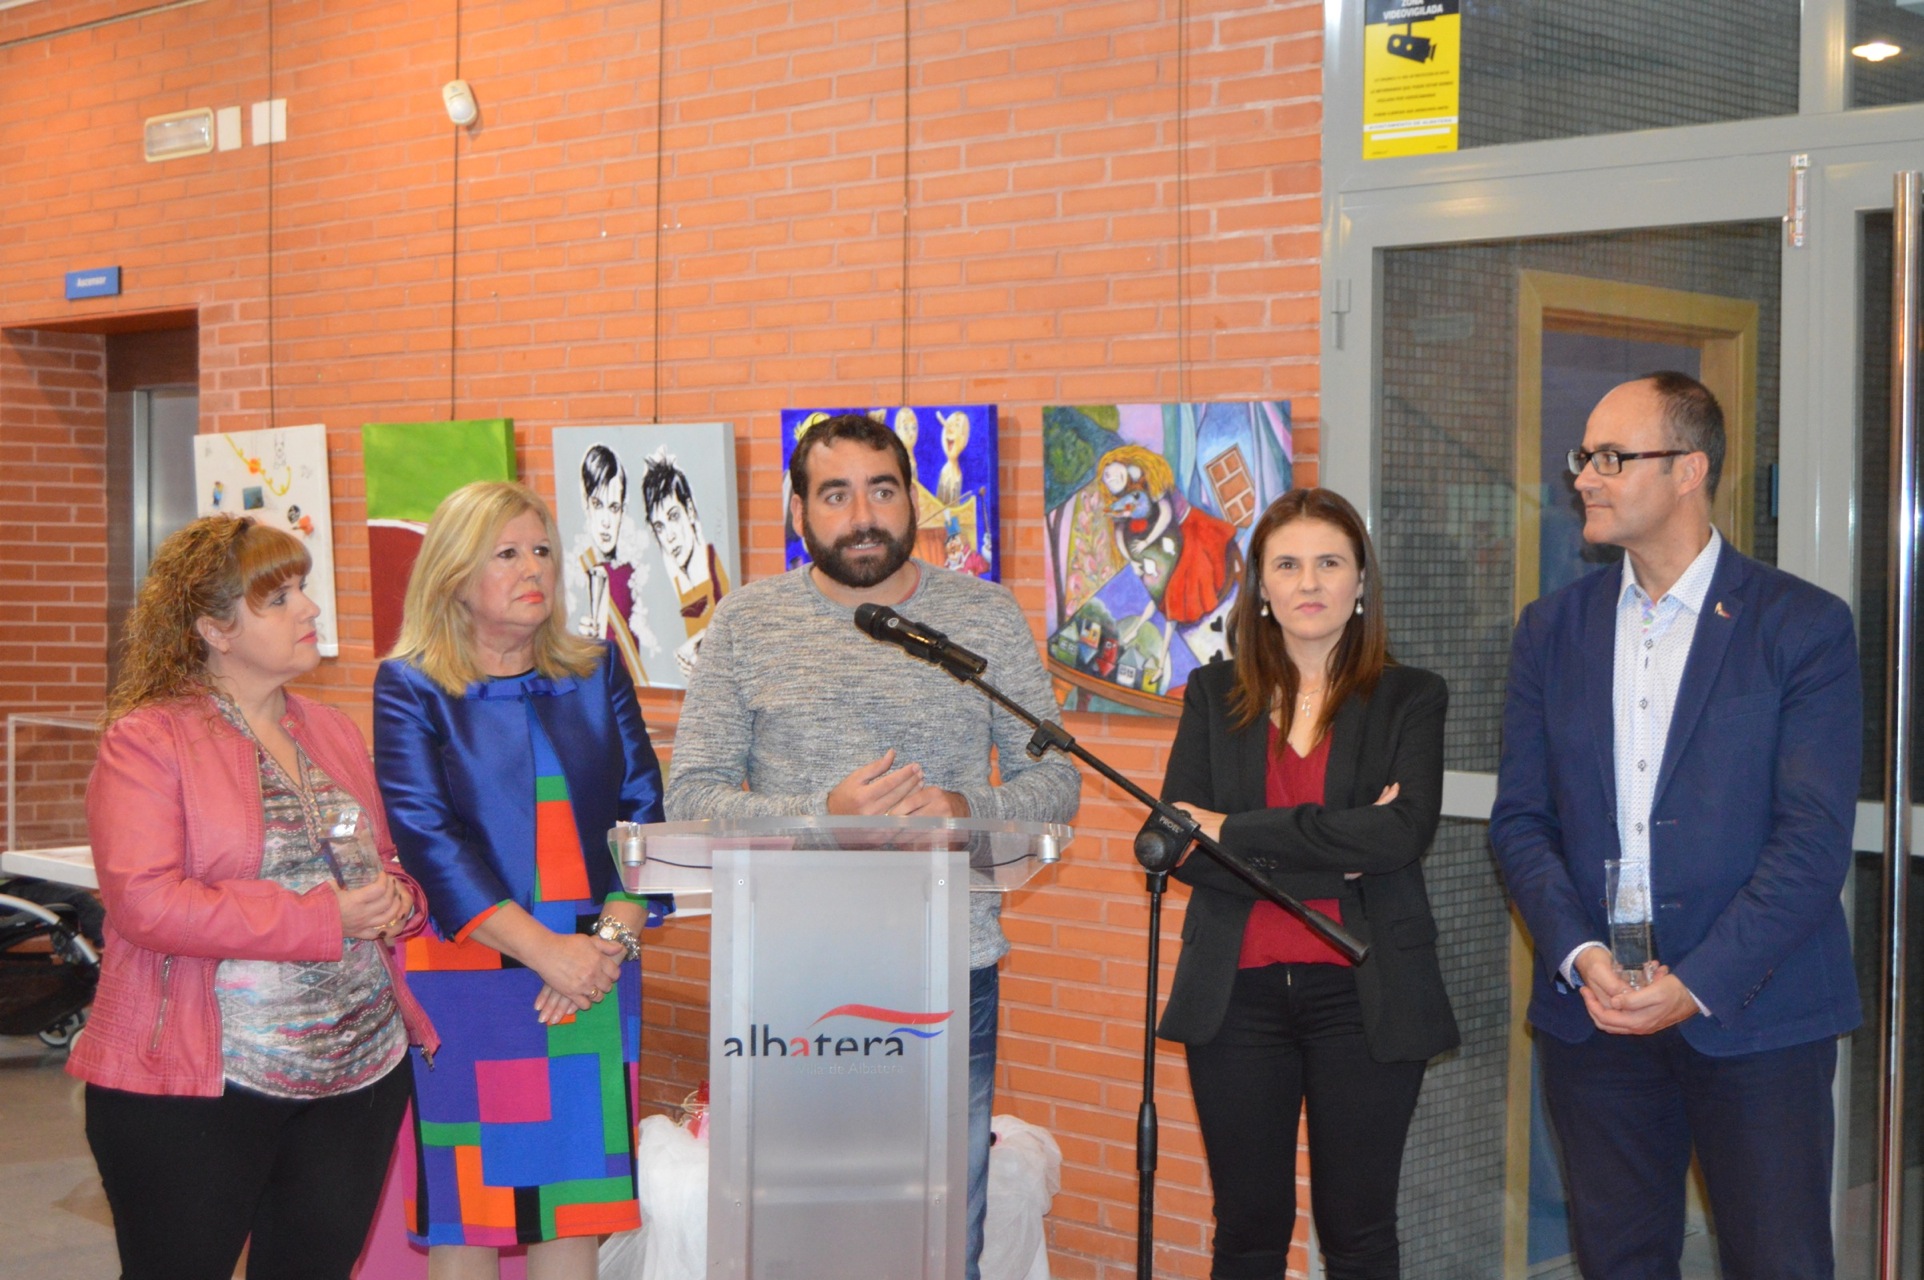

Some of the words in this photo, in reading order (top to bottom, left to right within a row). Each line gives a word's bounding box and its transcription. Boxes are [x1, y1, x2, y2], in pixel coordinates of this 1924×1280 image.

[1383, 4, 1443, 20] VIDEOVIGILADA
[724, 1024, 904, 1057] albatera
[829, 1063, 845, 1075] de
[848, 1062, 904, 1074] Albatera
